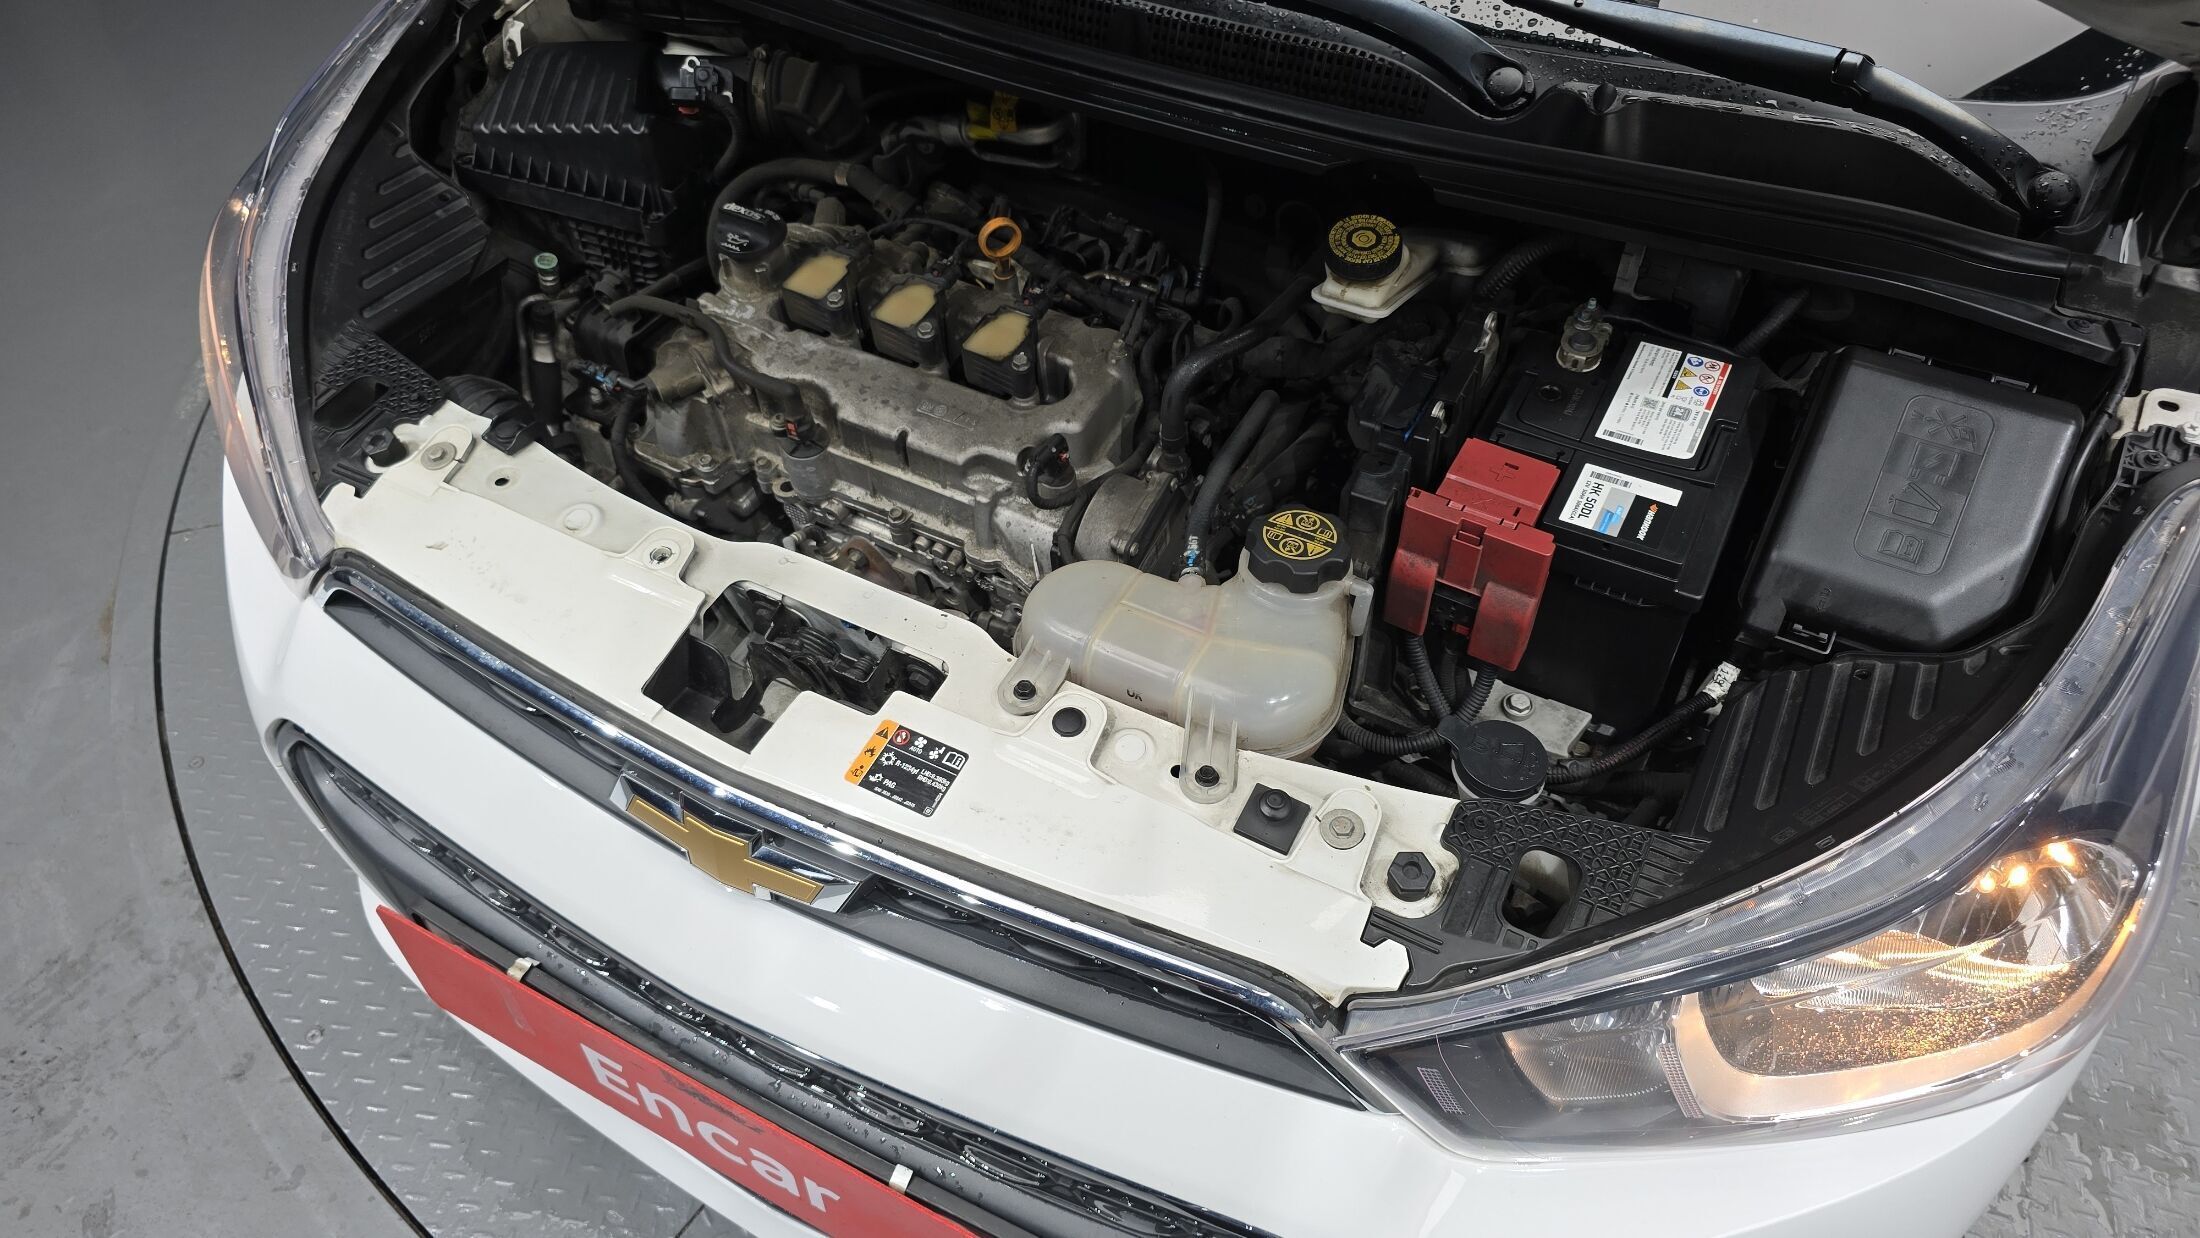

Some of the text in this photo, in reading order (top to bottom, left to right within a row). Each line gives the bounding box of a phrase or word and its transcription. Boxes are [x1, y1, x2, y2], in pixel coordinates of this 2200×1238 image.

[723, 203, 761, 220] dexos
[1578, 482, 1605, 519] HK 50DL
[908, 745, 923, 755] AUTO
[882, 779, 897, 789] PAG
[580, 1043, 840, 1213] Encar
